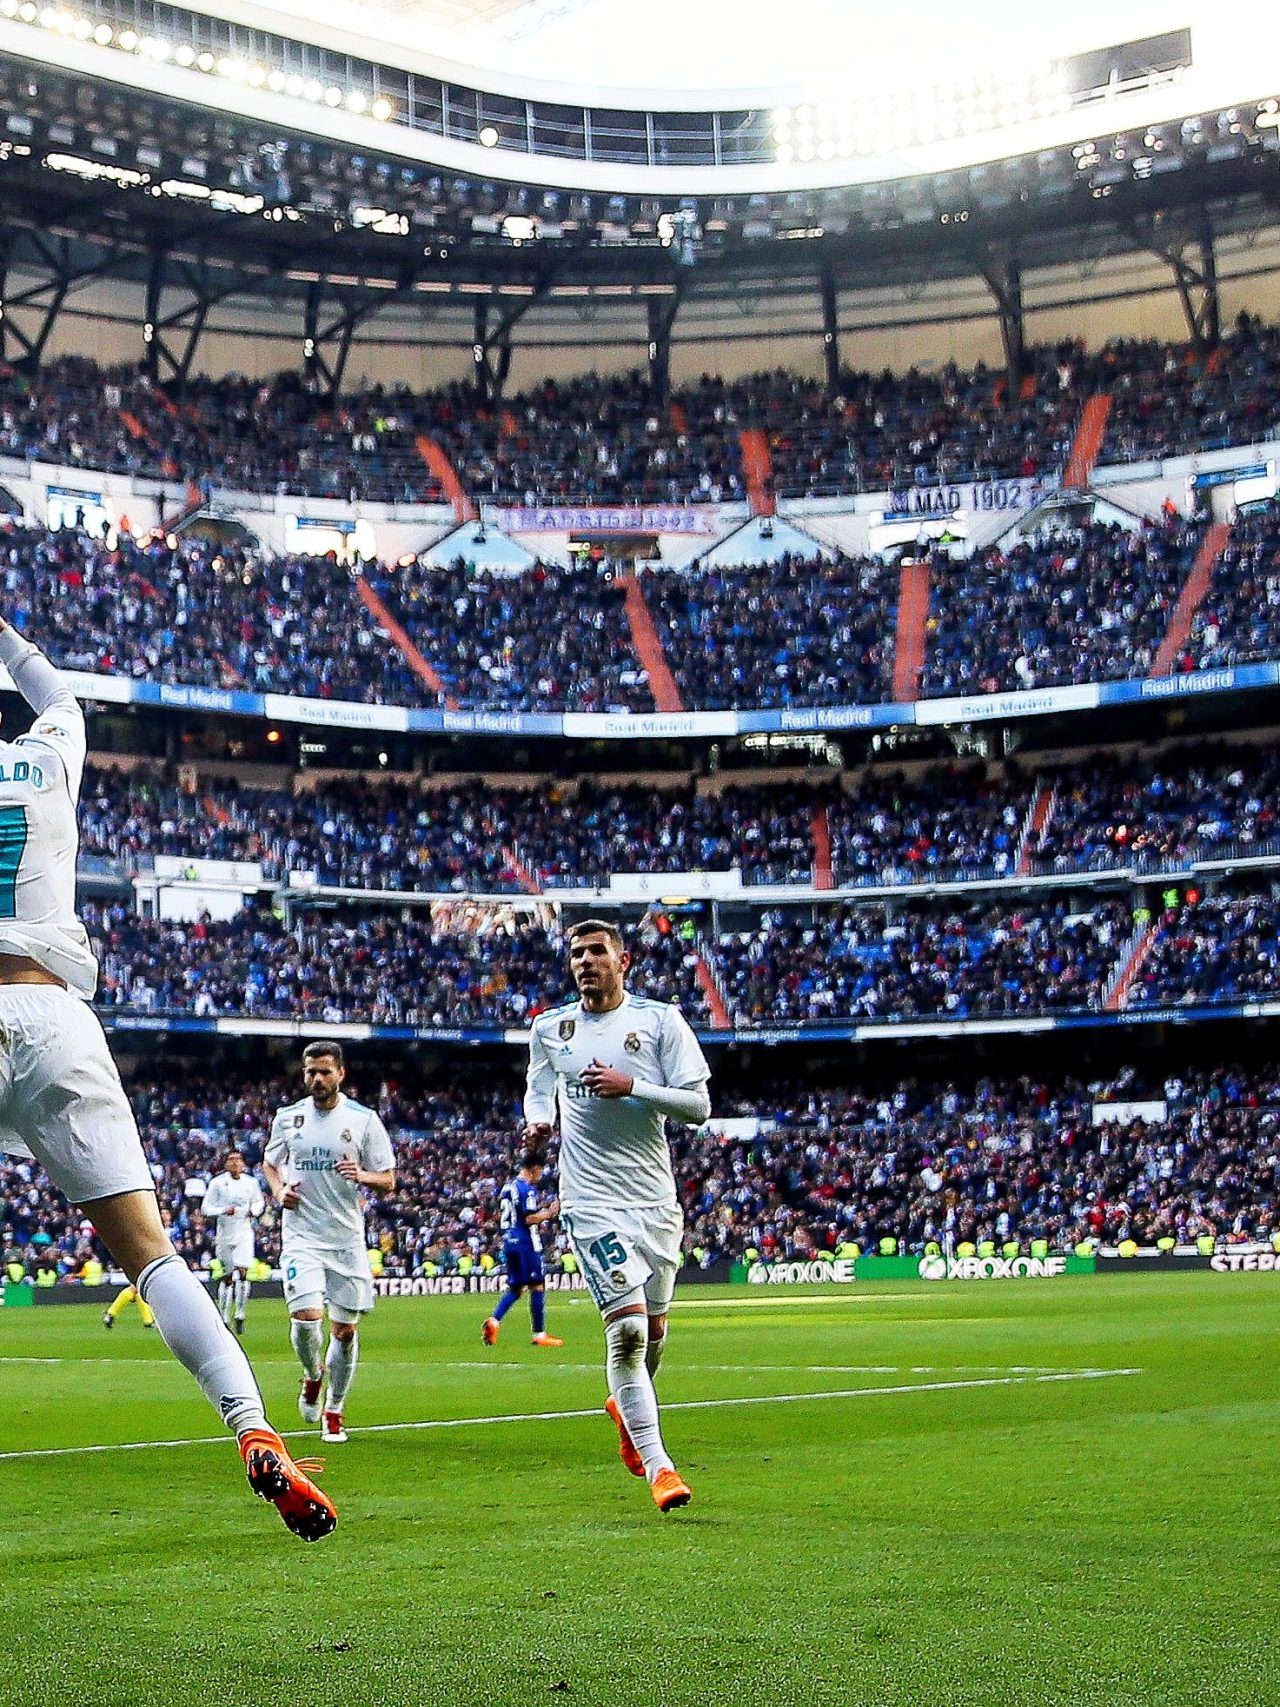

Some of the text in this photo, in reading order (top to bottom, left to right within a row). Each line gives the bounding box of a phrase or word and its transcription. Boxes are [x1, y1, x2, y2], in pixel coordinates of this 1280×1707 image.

[1141, 669, 1235, 697] Real Madrid
[588, 1231, 627, 1272] 15
